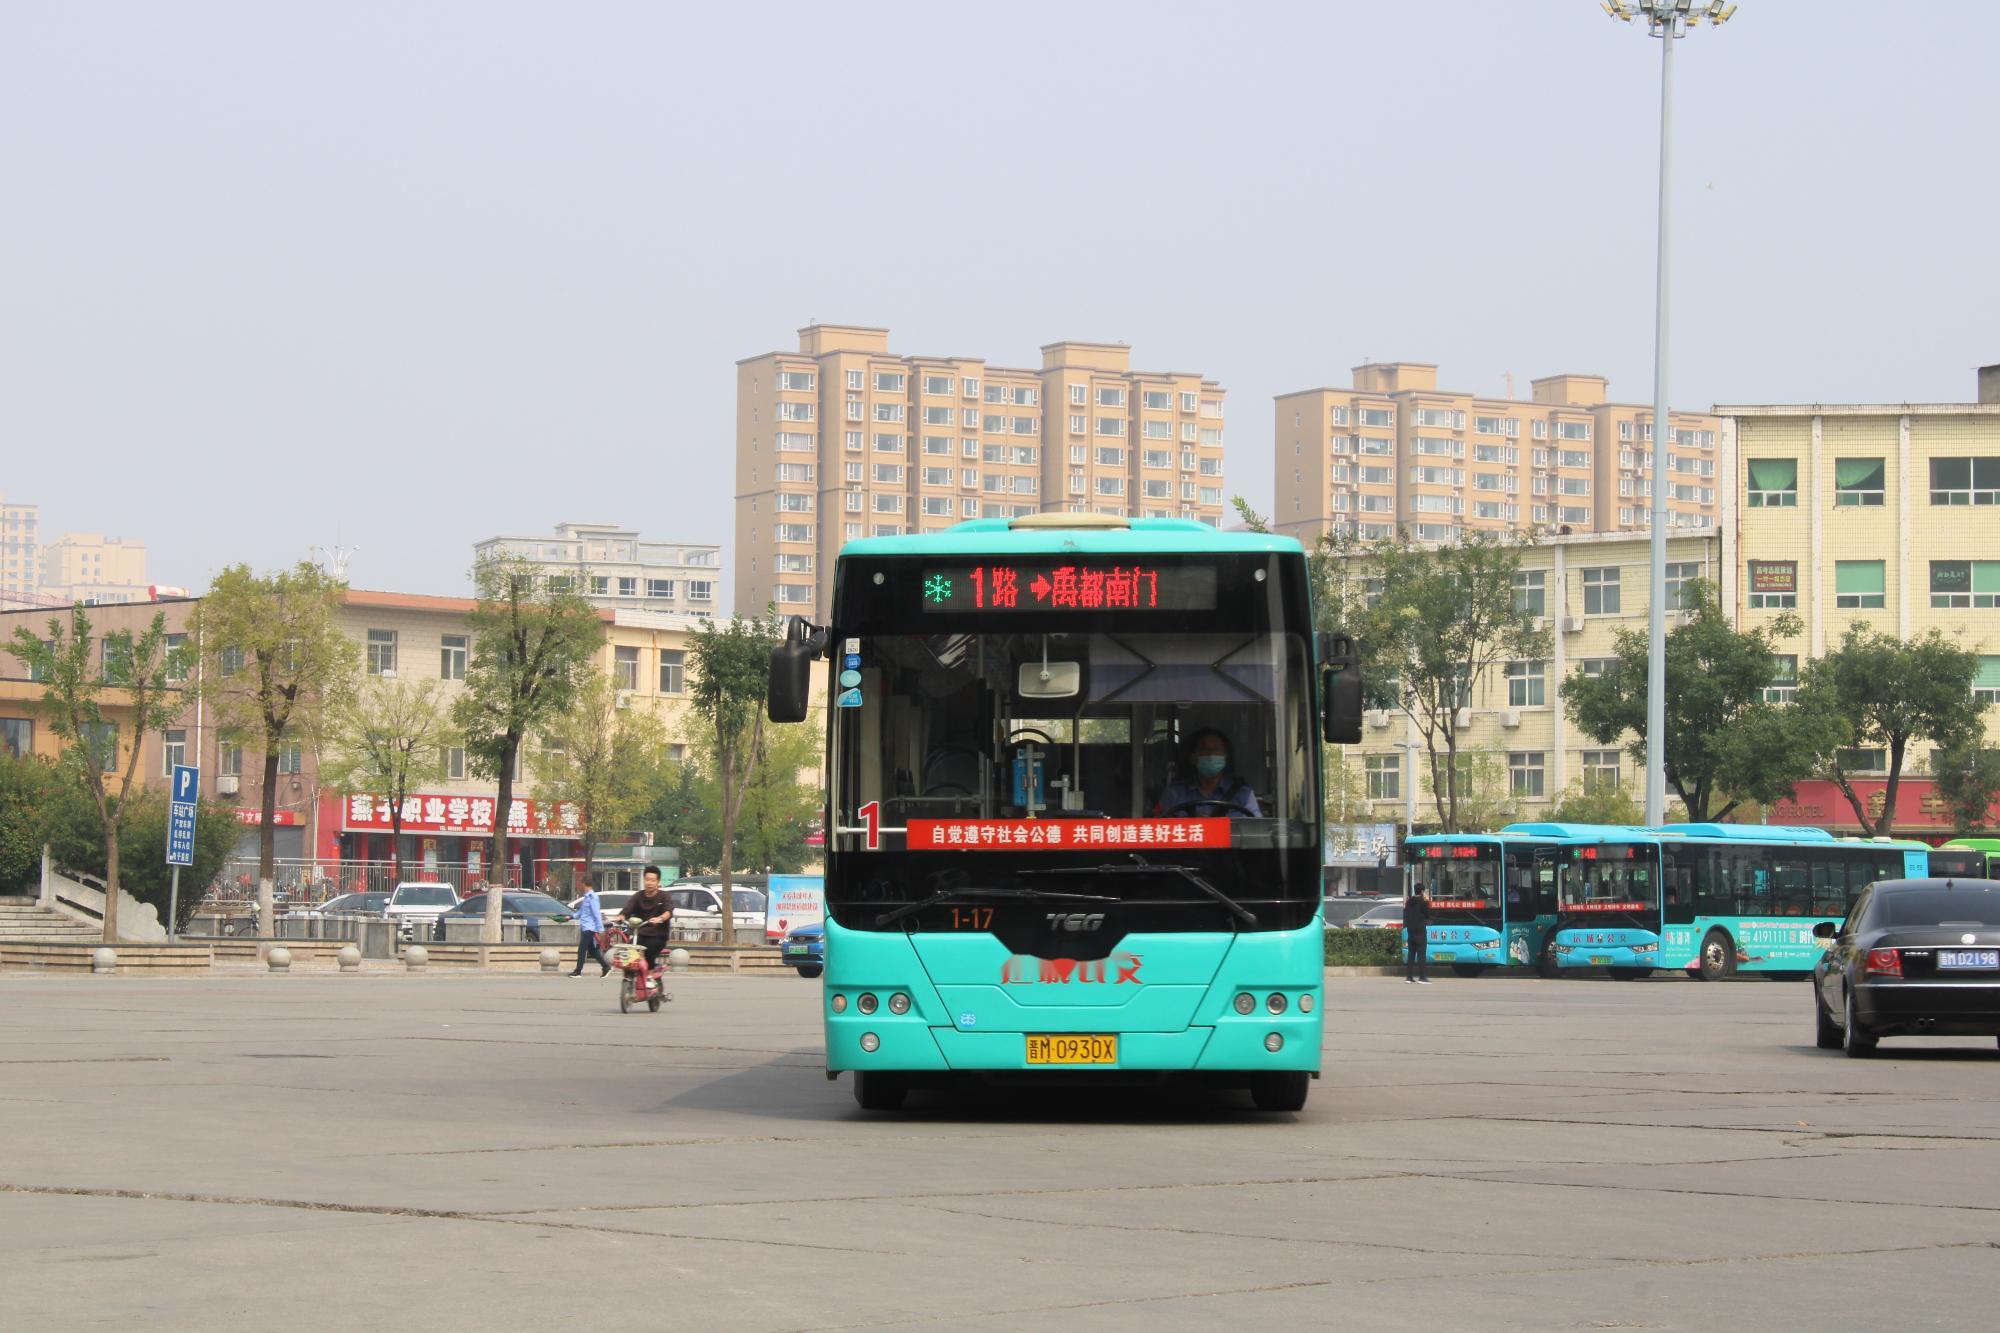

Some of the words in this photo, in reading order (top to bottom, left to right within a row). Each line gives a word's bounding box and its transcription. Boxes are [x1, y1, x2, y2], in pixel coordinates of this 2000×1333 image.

[180, 770, 190, 797] P
[173, 805, 194, 818] 车站广场
[351, 794, 492, 826] 燕子职业学校
[858, 801, 879, 849] 1
[931, 825, 1063, 845] 自觉遵守社会公德
[1073, 823, 1204, 844] 共同创造美好生活
[1333, 835, 1389, 857] 停车场
[951, 908, 994, 929] 1-17
